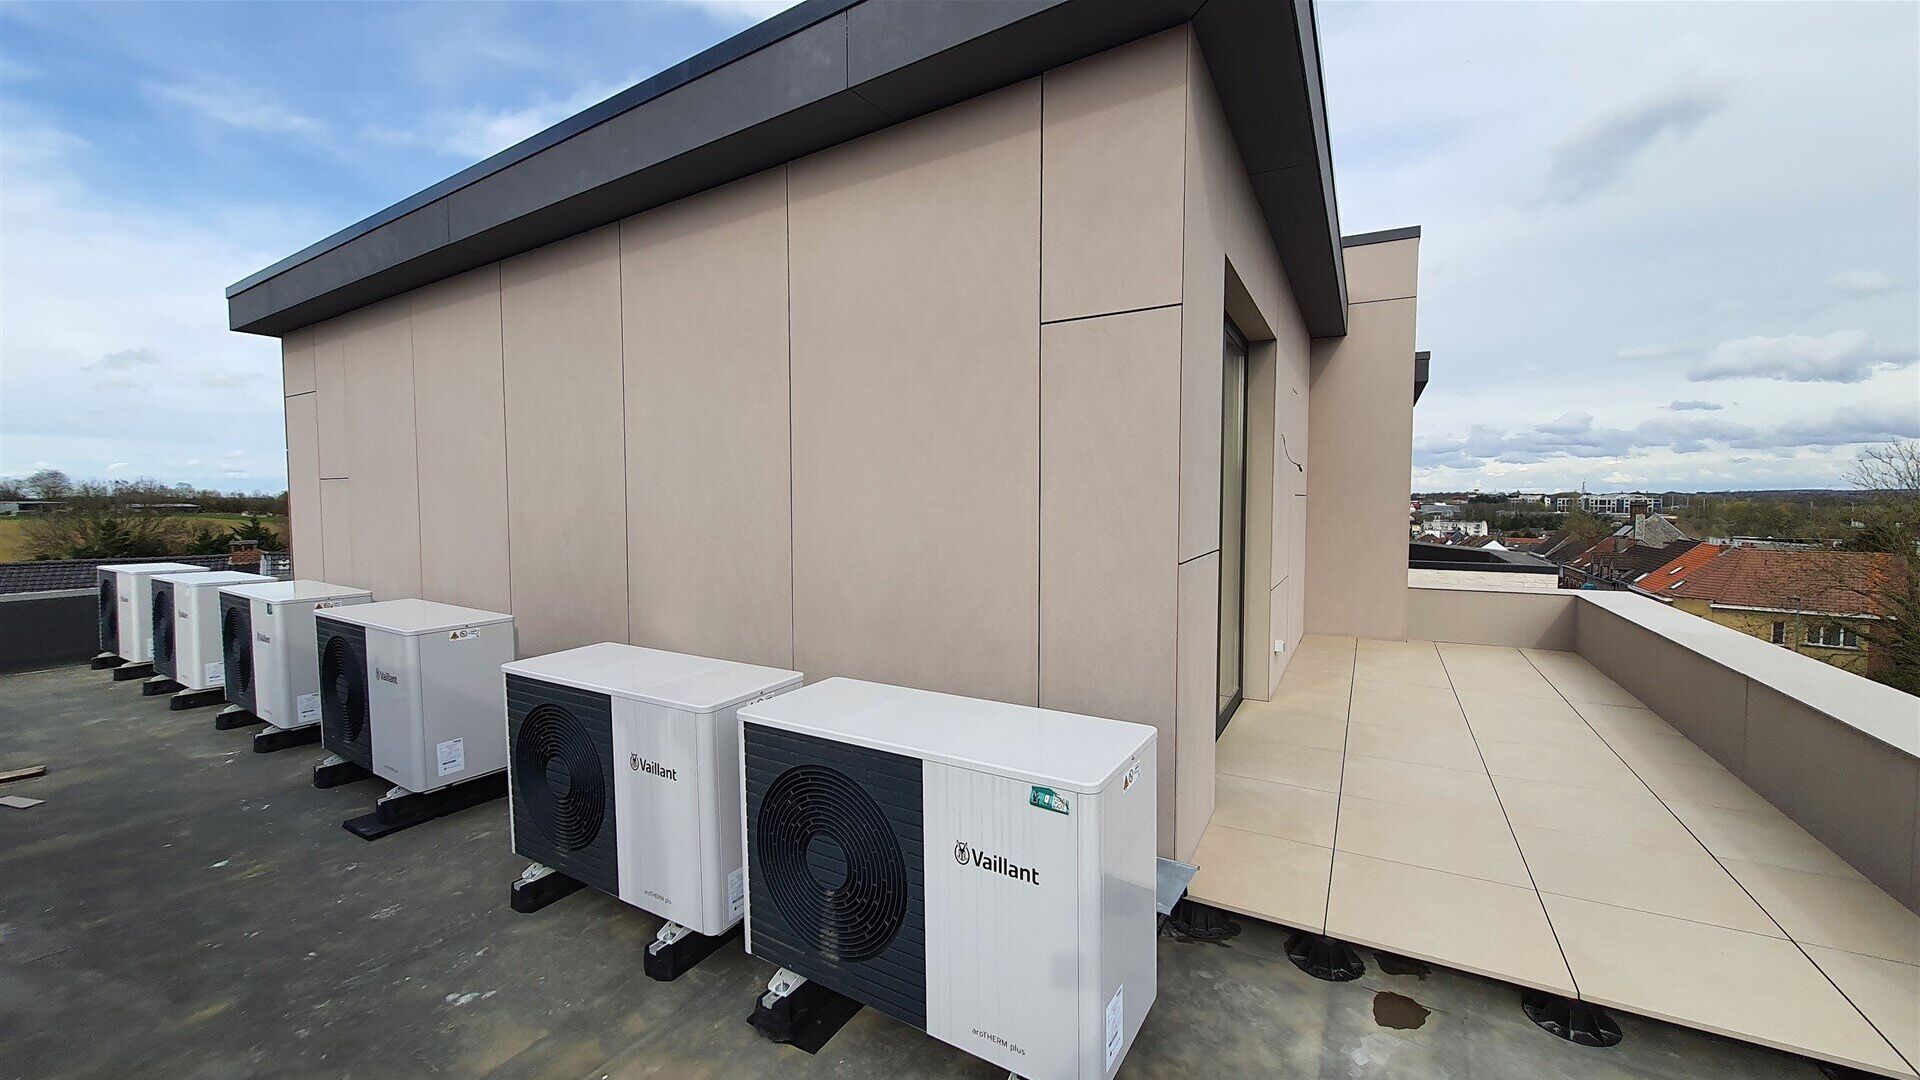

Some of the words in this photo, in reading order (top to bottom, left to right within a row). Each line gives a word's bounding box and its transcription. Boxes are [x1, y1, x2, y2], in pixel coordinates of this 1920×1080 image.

[639, 757, 677, 781] Vaillant
[971, 848, 1040, 886] Vaillant
[971, 1028, 1008, 1048] aroTHERM
[1009, 1044, 1026, 1056] plus
